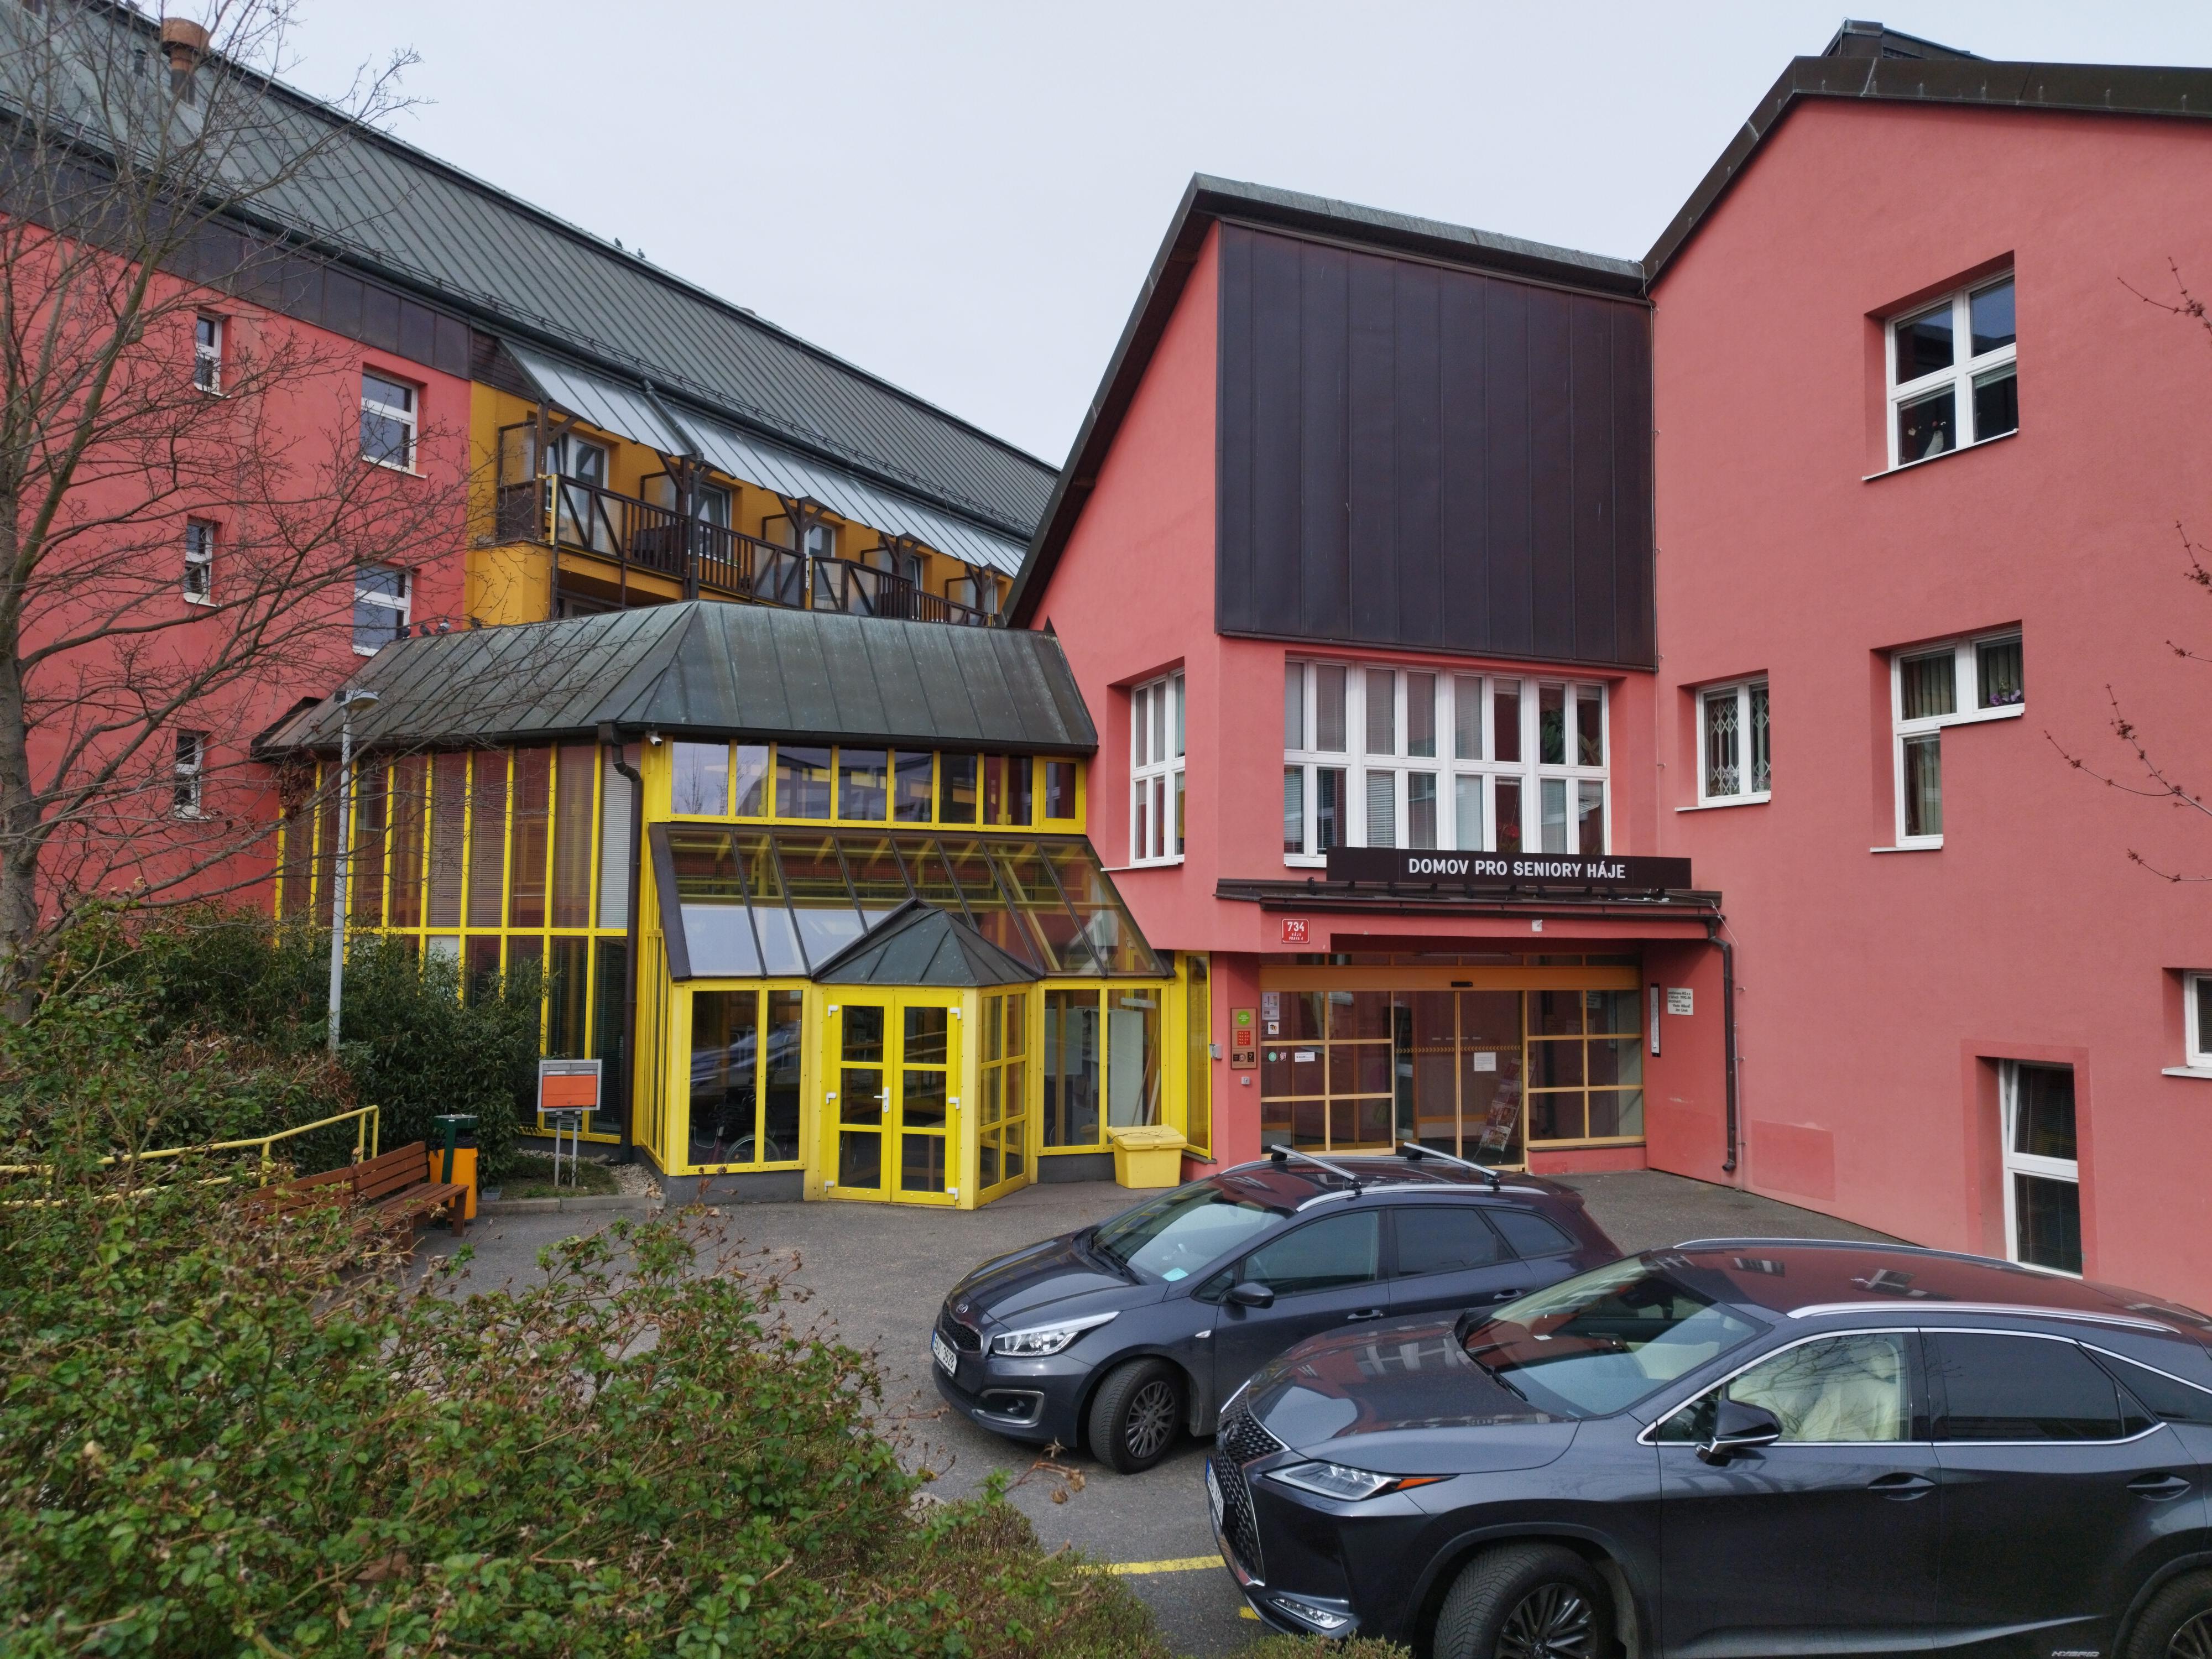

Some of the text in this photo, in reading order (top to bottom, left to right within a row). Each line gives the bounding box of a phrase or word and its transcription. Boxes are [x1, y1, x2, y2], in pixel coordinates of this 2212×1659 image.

[1408, 858, 1626, 878] DOMOV PRO SENIORY HÁJE
[1287, 921, 1305, 932] 734
[942, 1347, 954, 1369] 3628
